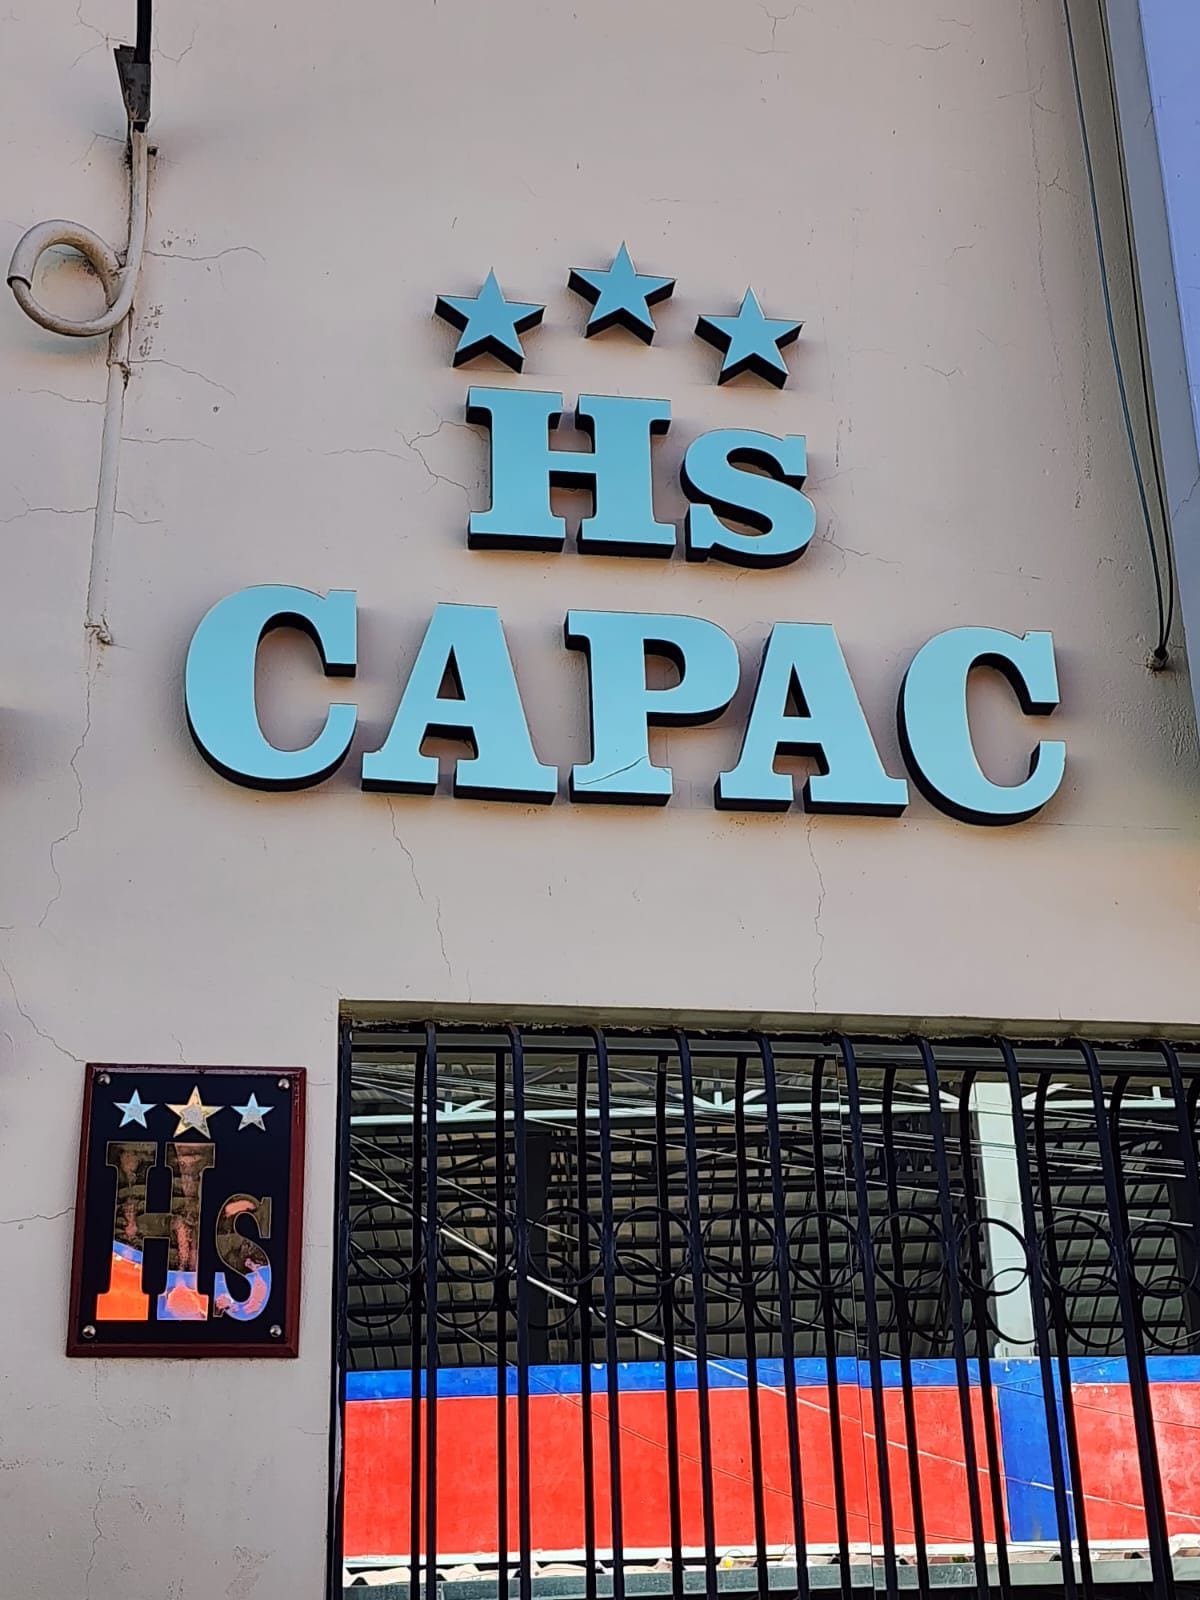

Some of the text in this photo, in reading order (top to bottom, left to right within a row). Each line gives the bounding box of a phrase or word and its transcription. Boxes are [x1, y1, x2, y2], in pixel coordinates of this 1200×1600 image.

[466, 386, 816, 568] Hs
[184, 584, 1066, 825] CAPAC
[95, 1141, 273, 1321] Hs
